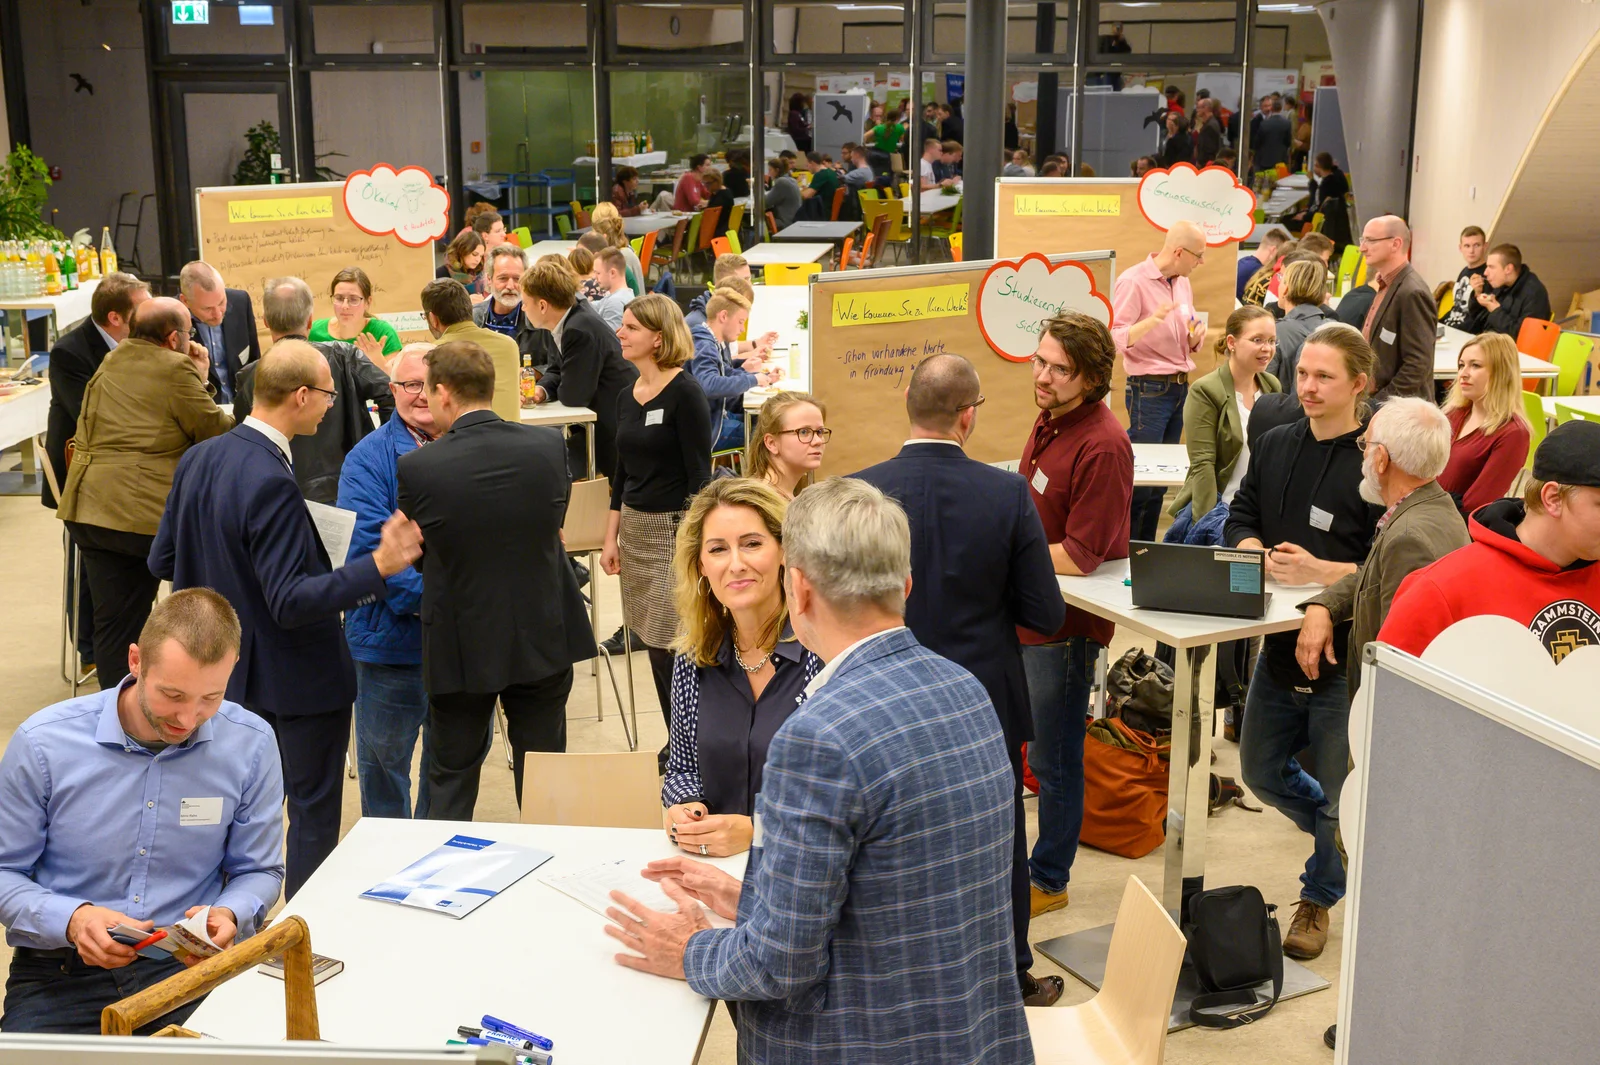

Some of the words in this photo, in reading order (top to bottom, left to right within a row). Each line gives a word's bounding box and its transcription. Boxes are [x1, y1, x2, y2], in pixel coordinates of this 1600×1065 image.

[1153, 180, 1233, 217] Genossenschaft
[997, 275, 1065, 315] Studierend
[837, 299, 859, 320] Wie
[898, 300, 912, 316] Sie
[915, 308, 923, 316] zu
[871, 343, 918, 360] vorhandene
[923, 339, 947, 355] Werte
[849, 368, 857, 379] in
